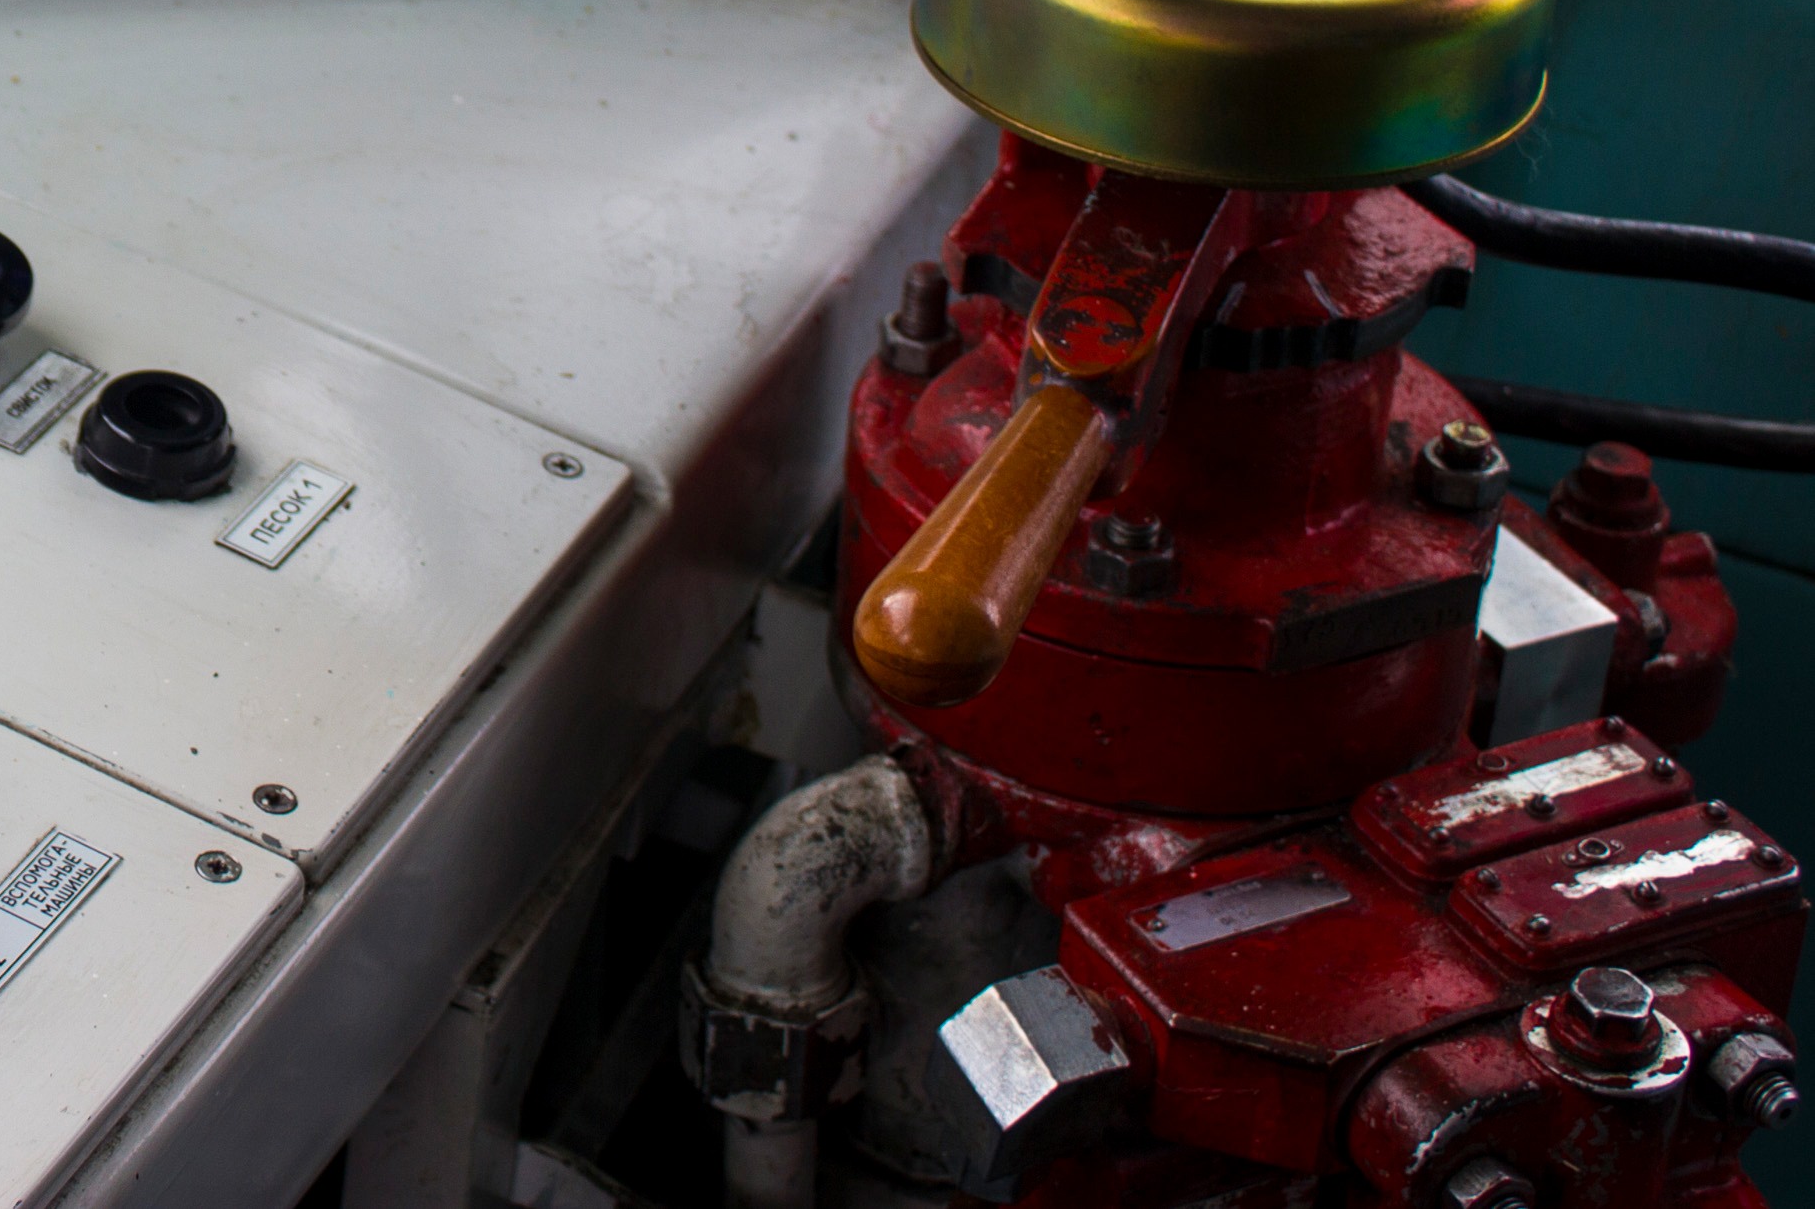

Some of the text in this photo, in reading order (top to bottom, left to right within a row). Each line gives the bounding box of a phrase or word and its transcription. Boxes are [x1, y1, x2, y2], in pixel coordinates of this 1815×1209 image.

[6, 375, 59, 418] СВИСТОК
[250, 477, 325, 545] ПЕСОК 1
[0, 839, 68, 908] ВСПОМОГА-
[21, 852, 82, 909] ТЕЛЬНЫЕ
[40, 862, 97, 918] МАШИНЫ
